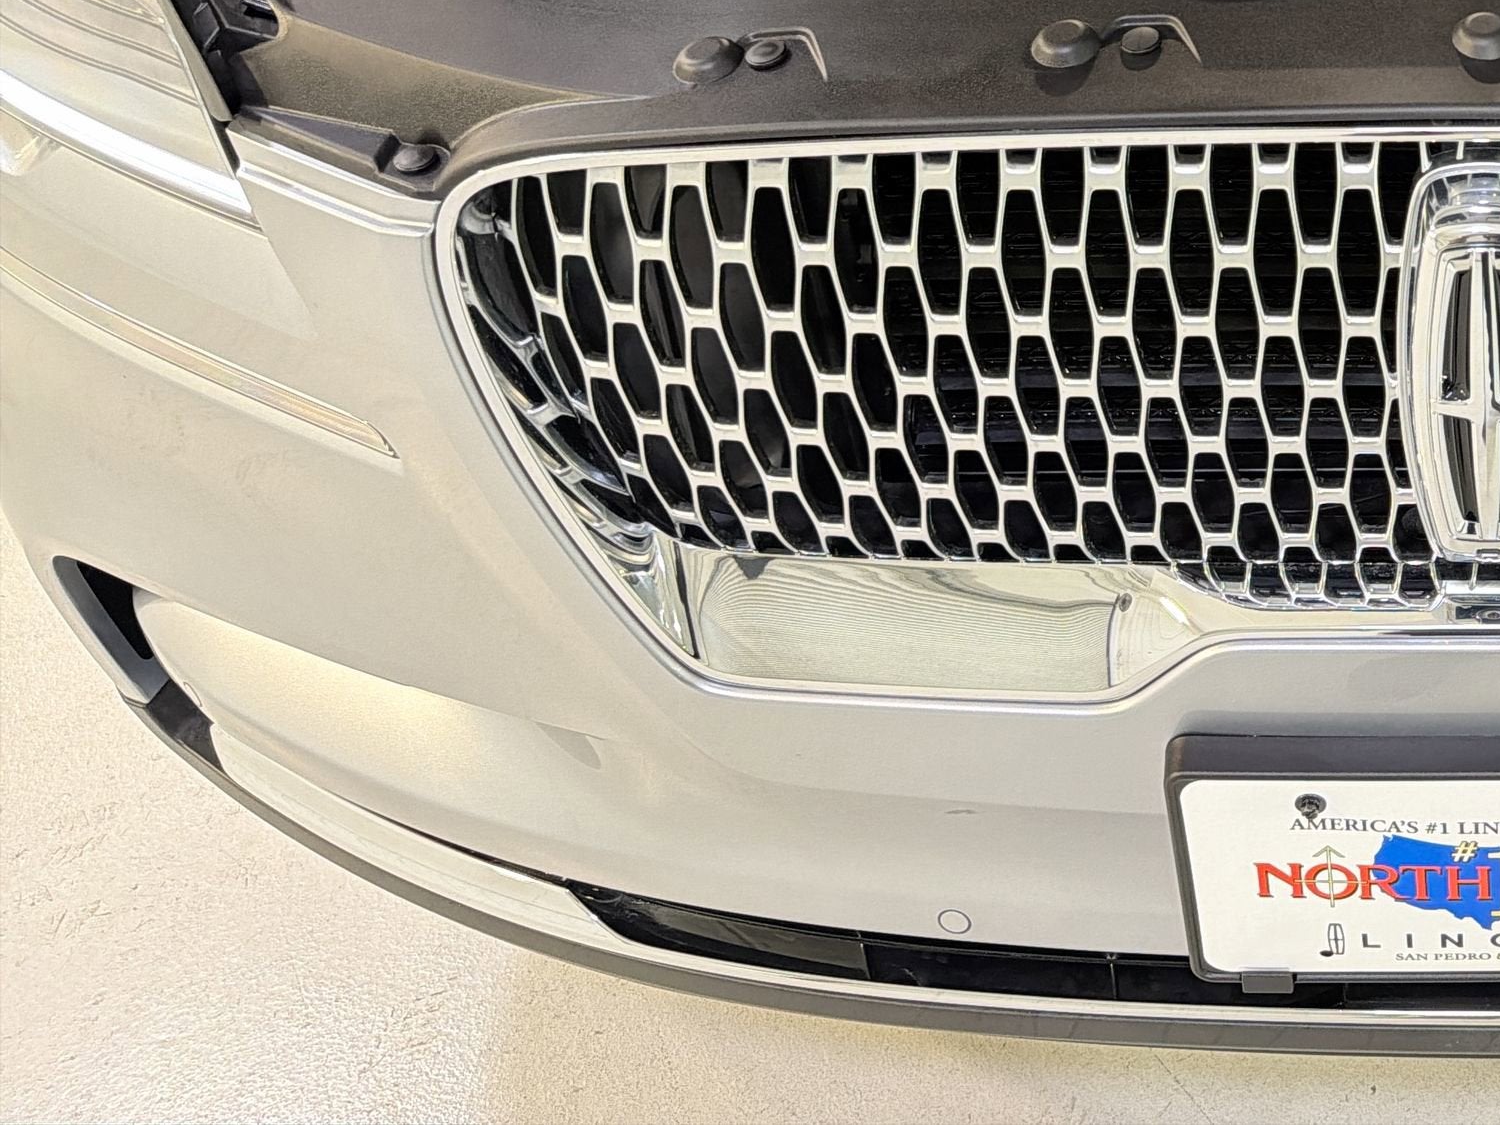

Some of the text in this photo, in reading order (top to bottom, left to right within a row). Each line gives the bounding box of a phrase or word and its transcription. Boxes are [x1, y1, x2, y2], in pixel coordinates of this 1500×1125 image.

[1290, 817, 1419, 834] AMERICA'S
[1425, 821, 1451, 835] #1
[1253, 861, 1494, 902] NORTH
[1395, 952, 1429, 961] SAN
[1434, 952, 1492, 961] PEDRO
